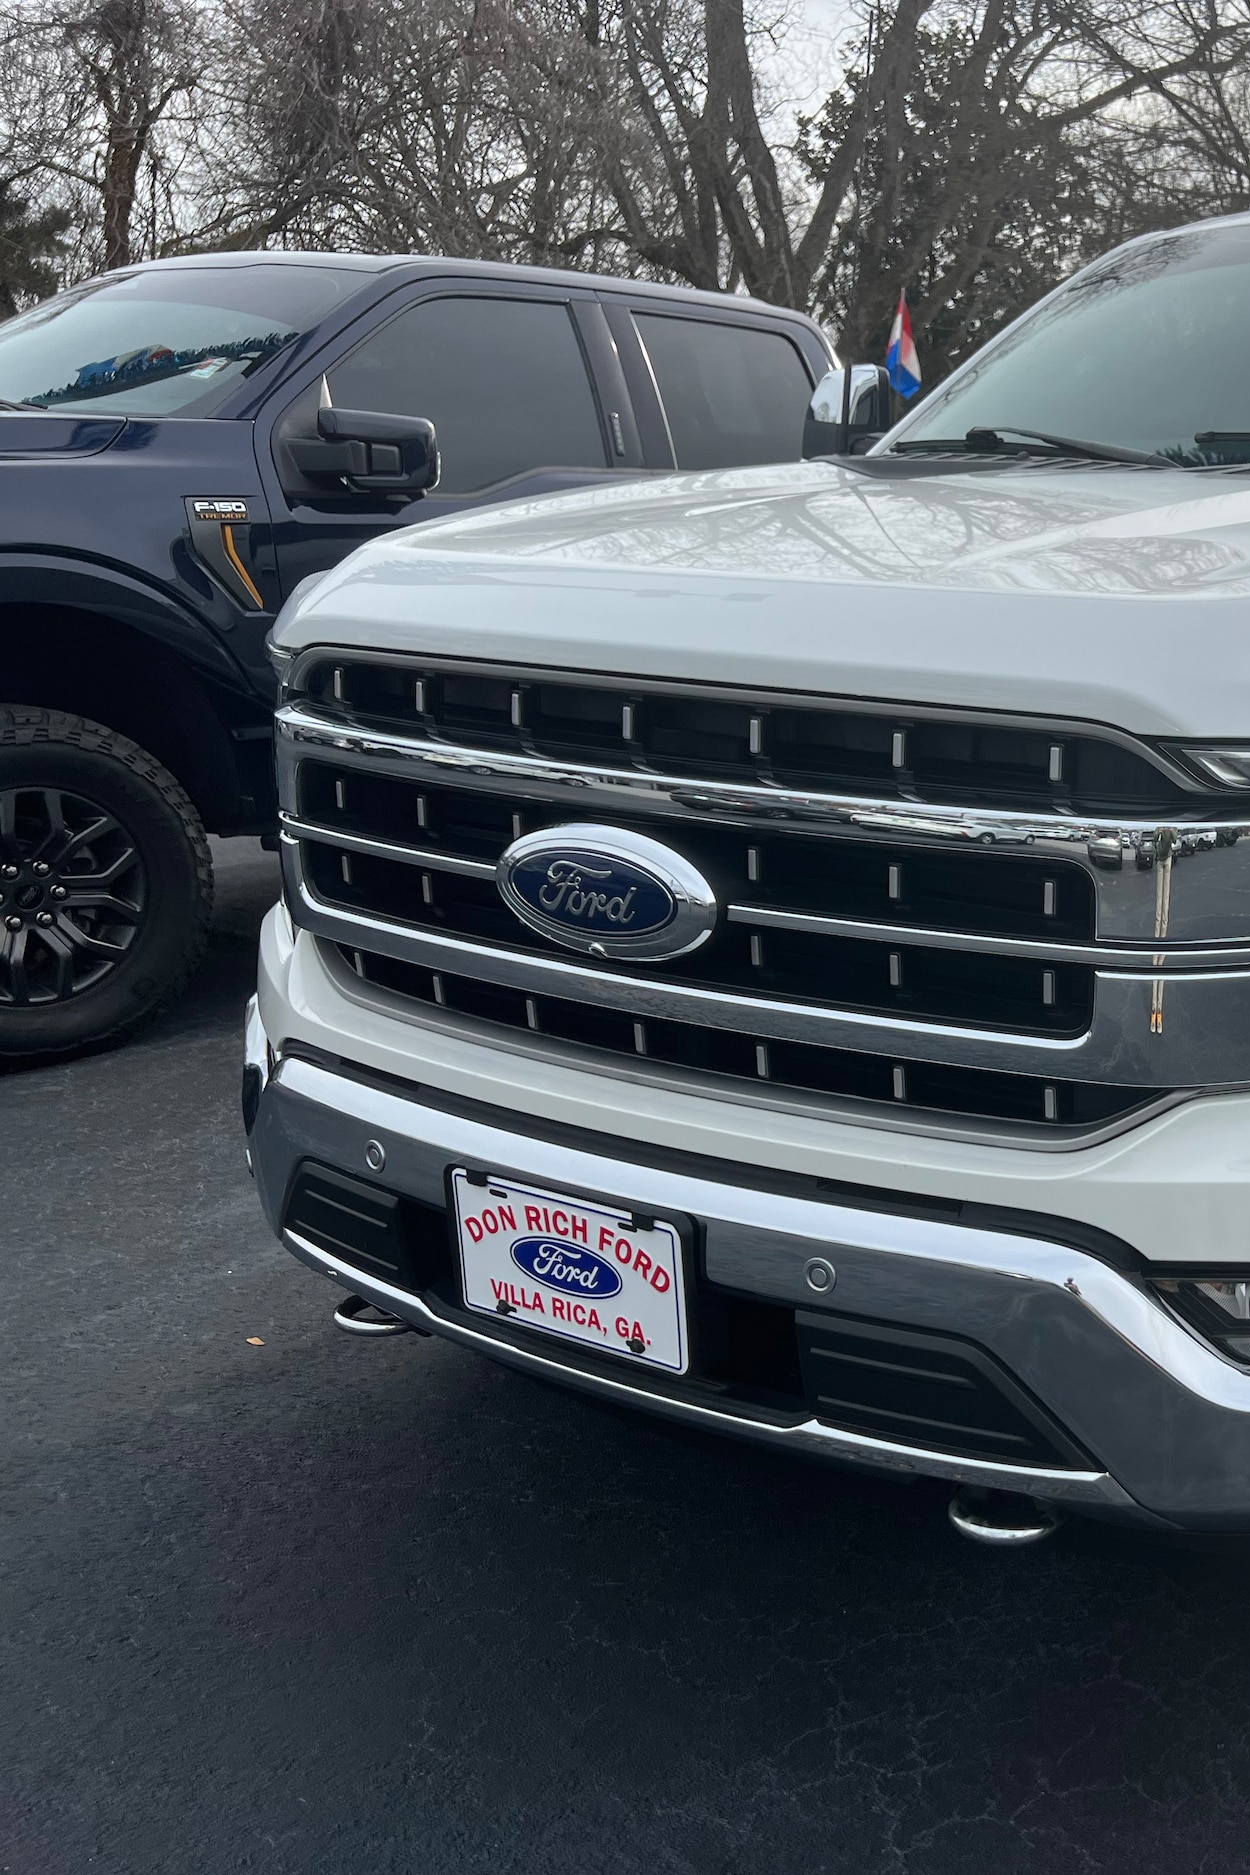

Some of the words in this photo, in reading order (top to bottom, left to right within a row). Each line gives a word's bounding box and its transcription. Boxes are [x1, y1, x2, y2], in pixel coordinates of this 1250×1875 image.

[538, 859, 638, 924] Ford
[464, 1205, 517, 1243] DON
[524, 1206, 588, 1243] RICH
[599, 1226, 671, 1294] FORD
[532, 1243, 599, 1289] Ford
[489, 1278, 546, 1314] VILLA
[551, 1297, 608, 1337] RICA,
[615, 1316, 652, 1346] GA.
